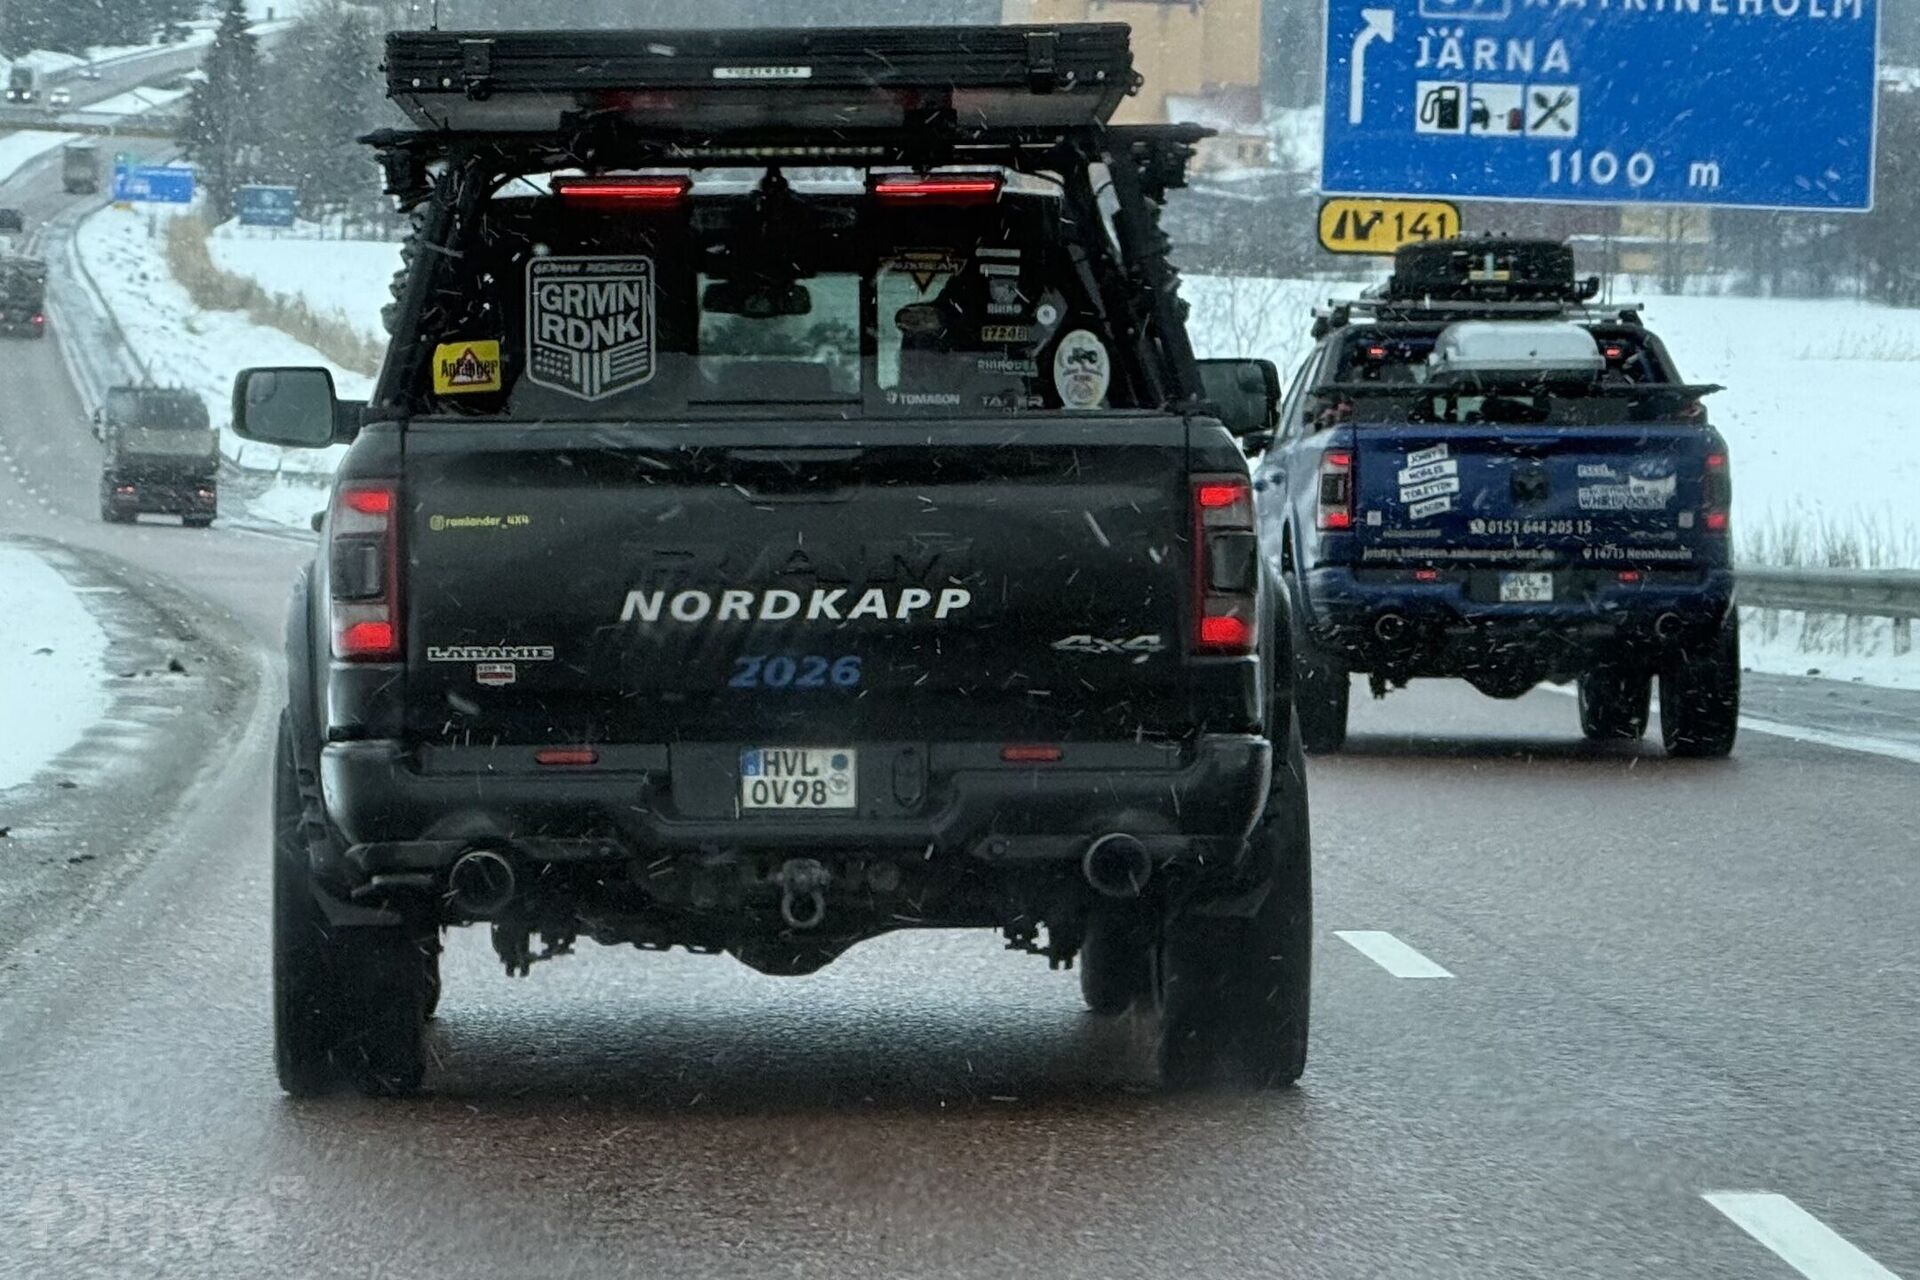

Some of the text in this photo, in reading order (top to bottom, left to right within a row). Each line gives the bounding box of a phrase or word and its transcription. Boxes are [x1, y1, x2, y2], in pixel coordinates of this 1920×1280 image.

[1415, 27, 1570, 73] JÄRNA
[1549, 150, 1720, 187] 1100 m
[1395, 207, 1446, 240] 141
[540, 282, 640, 318] GRMN
[541, 311, 640, 350] RDNK
[1488, 519, 1593, 535] 0151 644 205 15
[620, 587, 972, 622] NORDKAPP
[427, 646, 554, 661] LARAMIE
[728, 655, 862, 689] 2026
[763, 751, 819, 777] HVL
